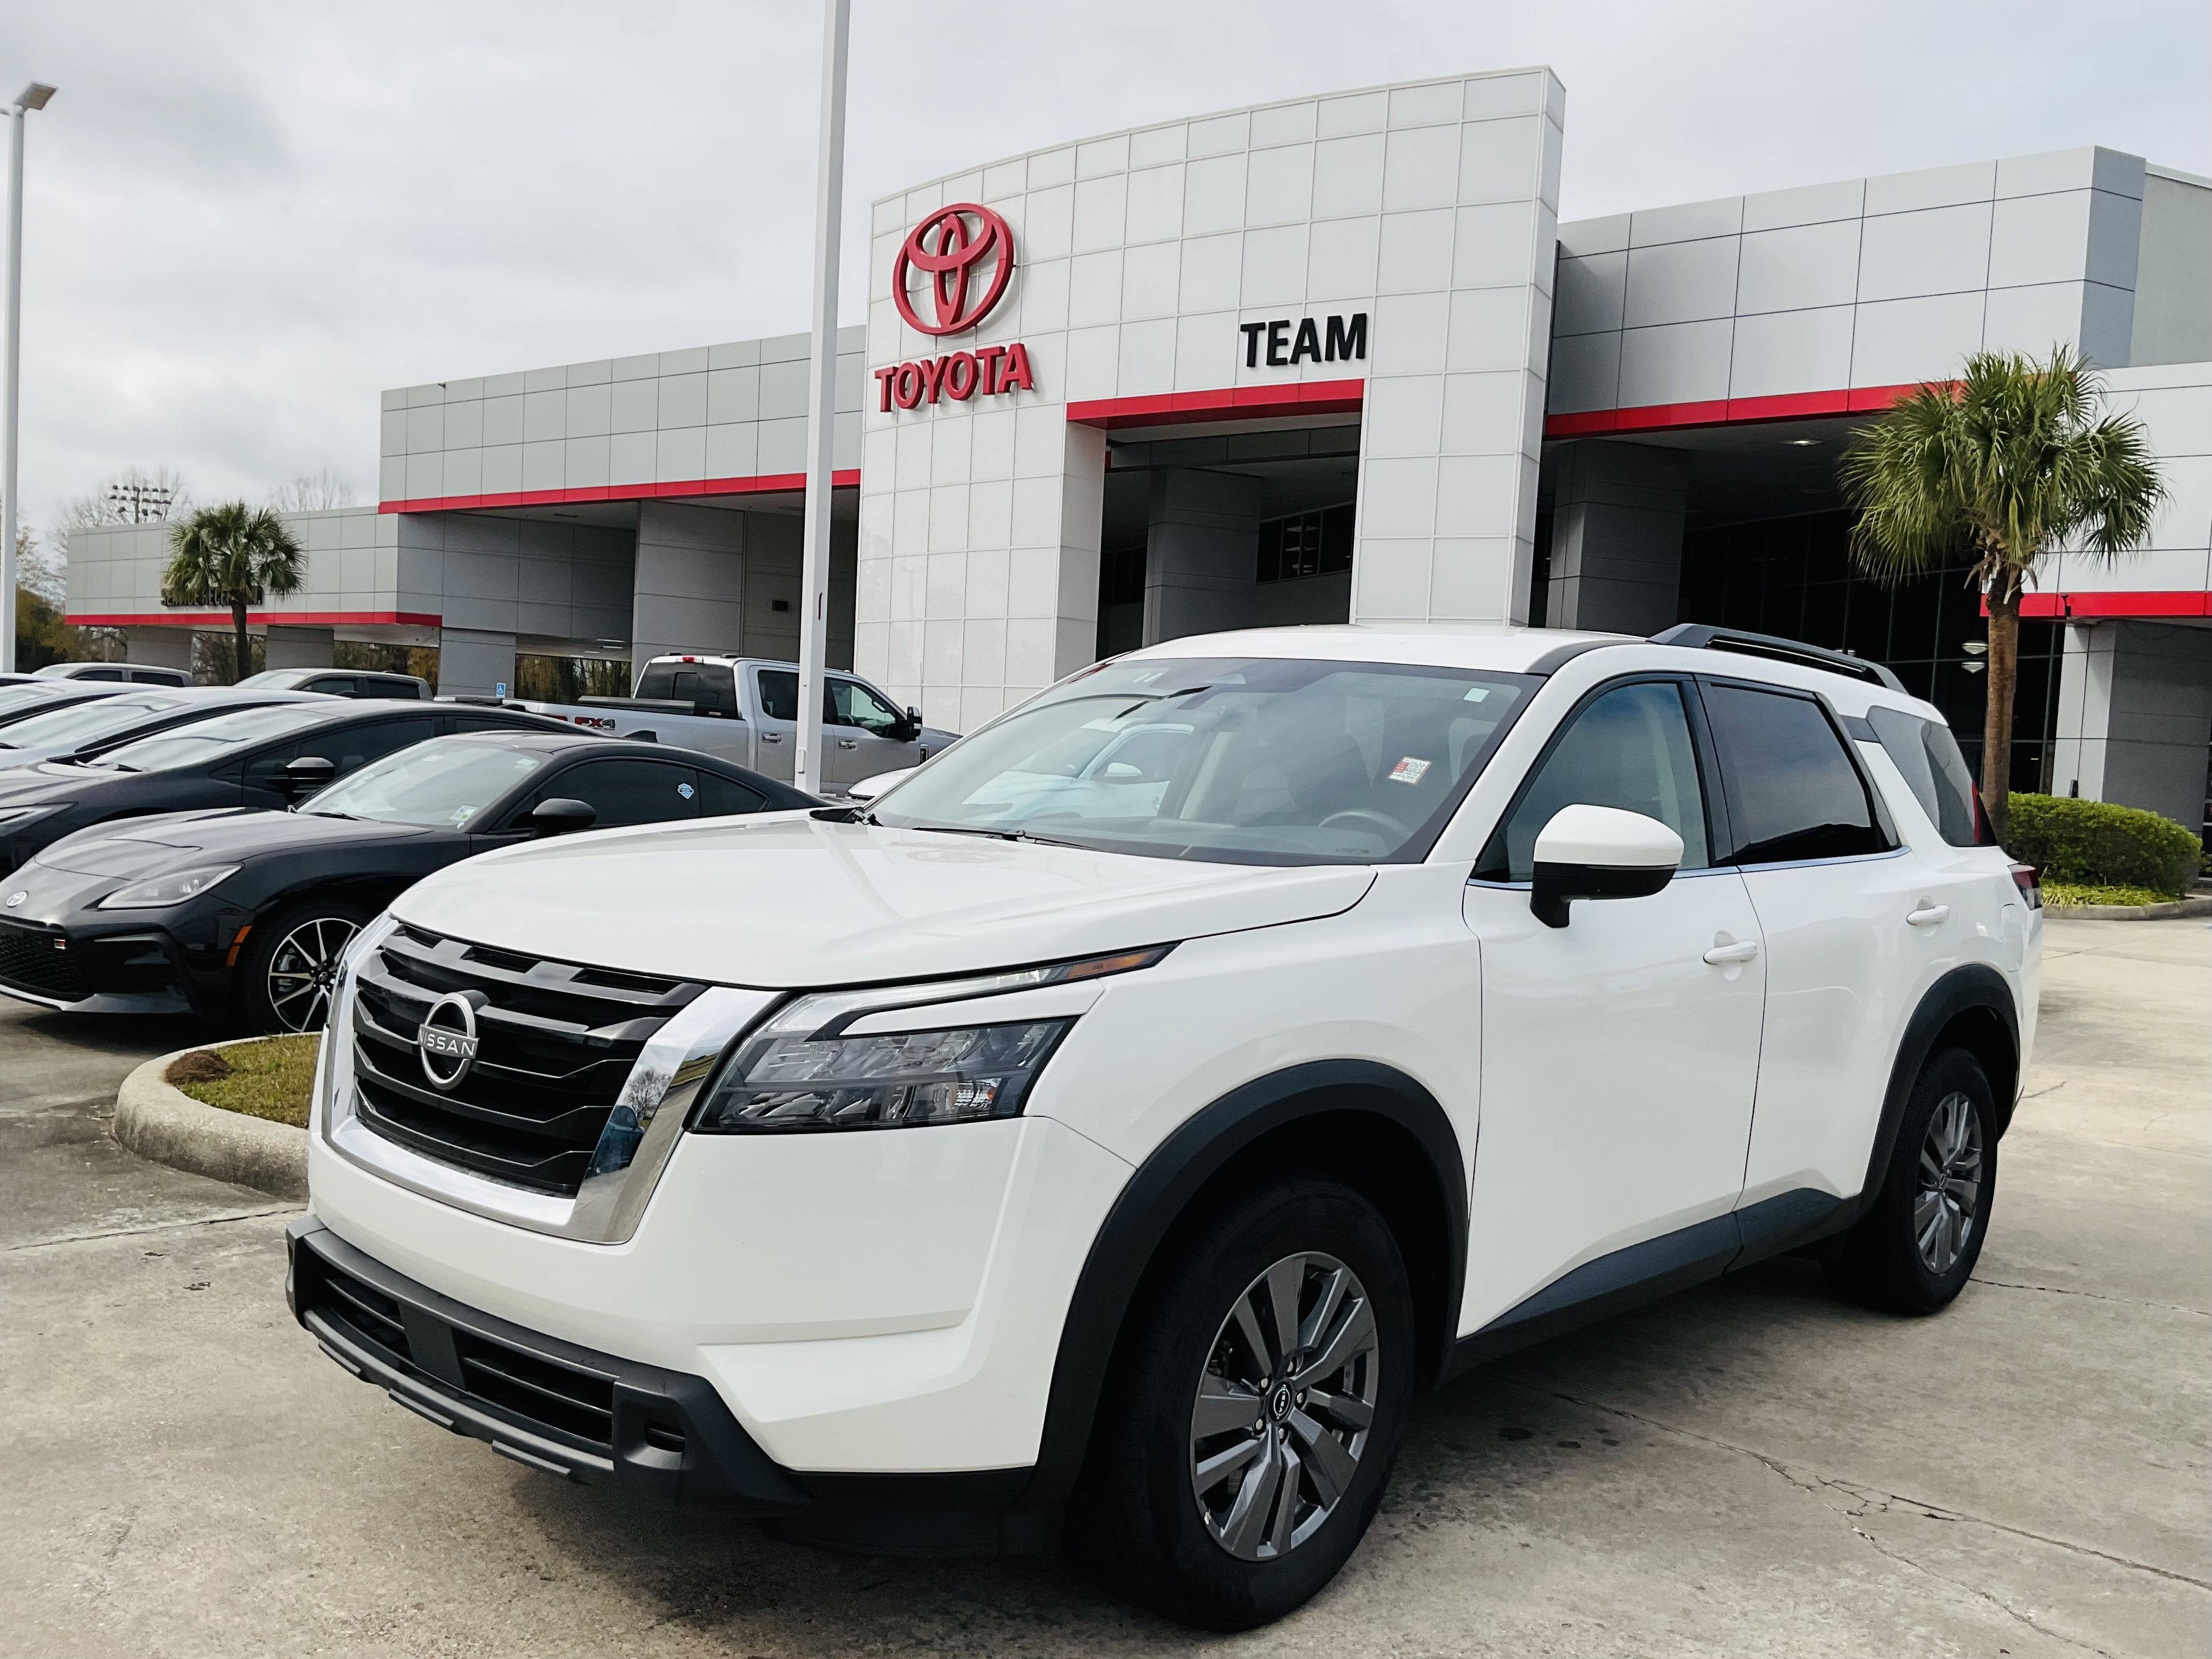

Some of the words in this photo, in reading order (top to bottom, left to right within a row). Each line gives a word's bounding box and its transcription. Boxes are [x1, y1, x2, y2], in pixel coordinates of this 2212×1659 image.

[1240, 313, 1367, 367] TEAM
[875, 343, 1034, 412] TOYOTA
[575, 716, 615, 729] FX4
[418, 1028, 475, 1056] NISSAN
